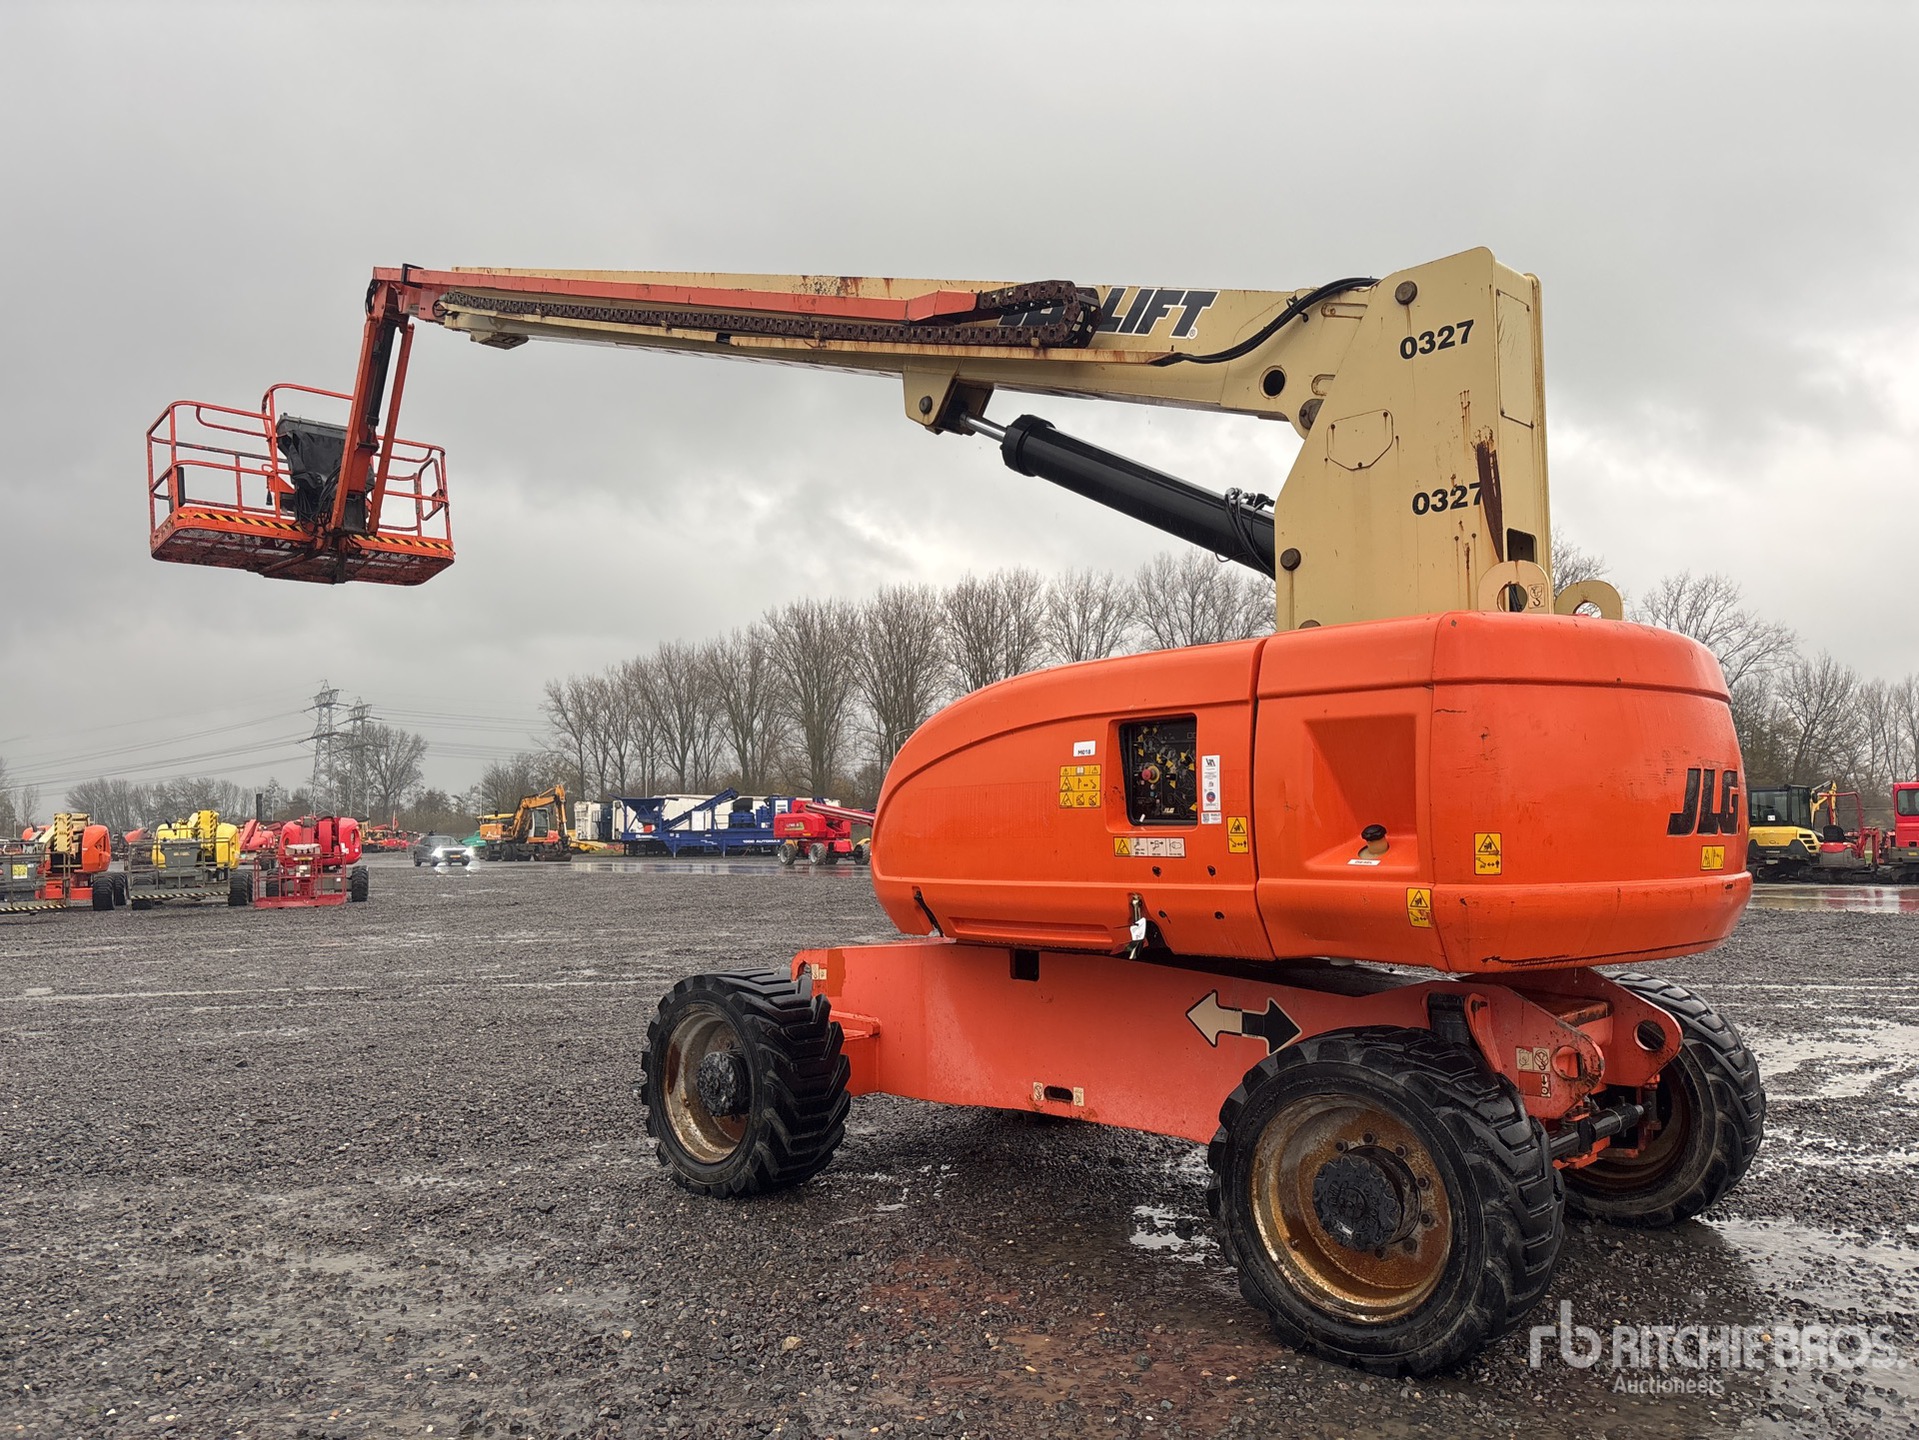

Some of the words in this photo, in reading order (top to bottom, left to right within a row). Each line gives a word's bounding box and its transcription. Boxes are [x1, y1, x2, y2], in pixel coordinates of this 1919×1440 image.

[1400, 319, 1474, 360] 0327
[1412, 482, 1482, 515] 0327
[1666, 768, 1738, 836] JLG
